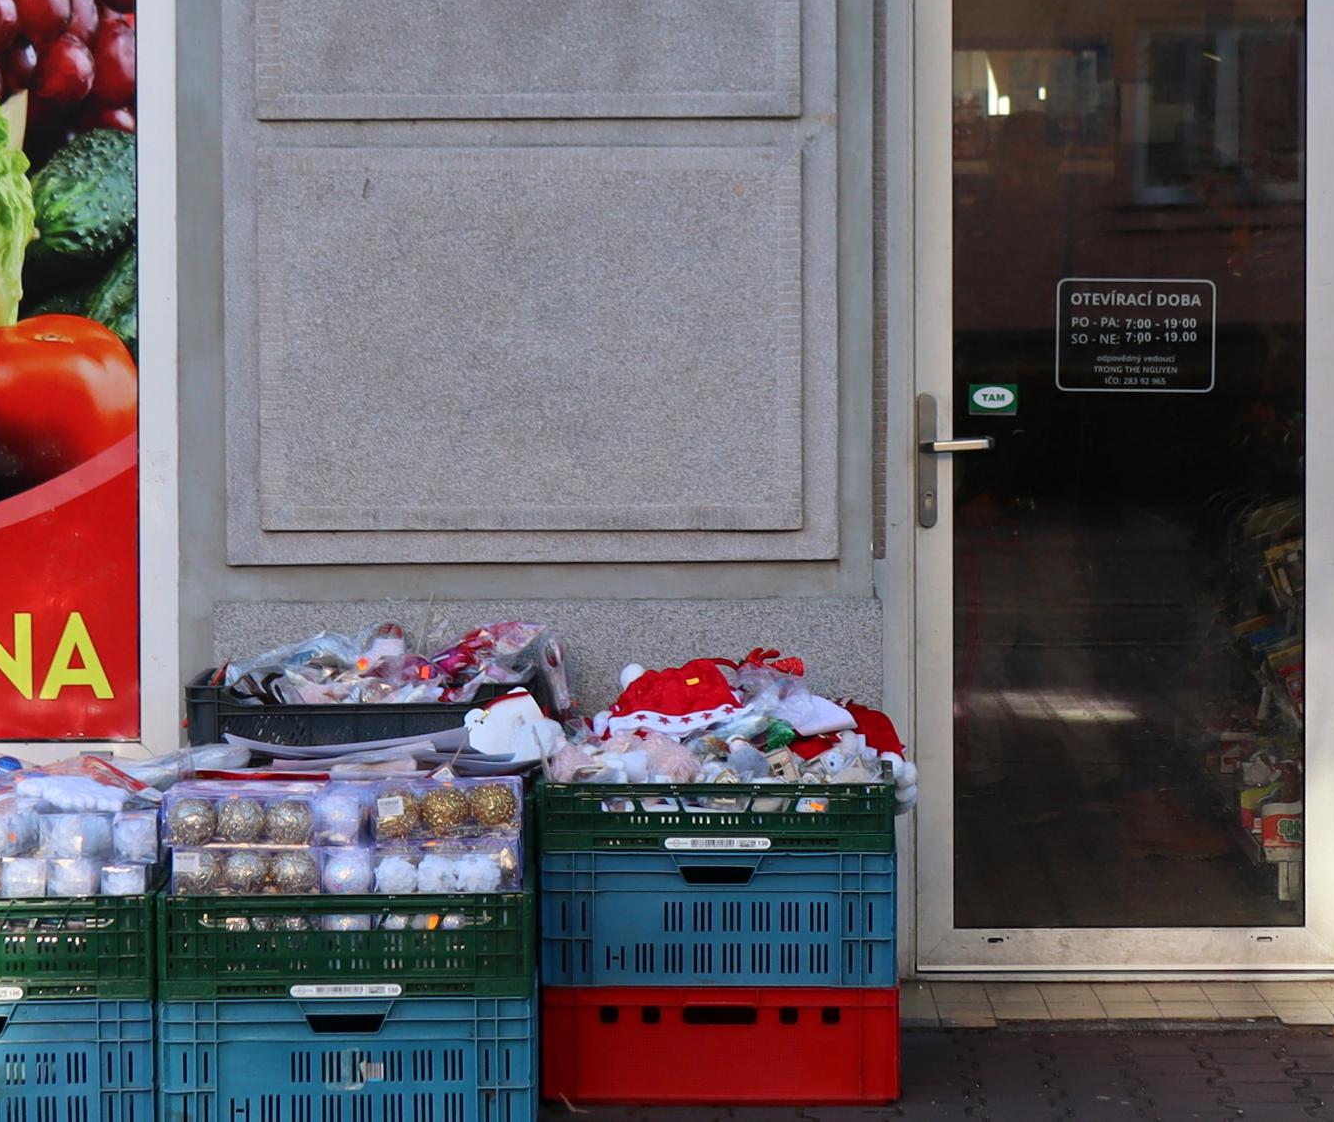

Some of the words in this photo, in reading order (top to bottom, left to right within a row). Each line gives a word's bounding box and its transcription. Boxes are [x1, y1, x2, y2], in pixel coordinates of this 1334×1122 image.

[1070, 290, 1153, 307] OTEVÍRACÍ
[1156, 293, 1202, 307] DOBA
[1071, 316, 1089, 328] PO
[1125, 318, 1152, 329] 7:00
[1071, 333, 1088, 345] SO
[1125, 332, 1152, 343] 7:00
[1094, 365, 1123, 374] TRONG
[1125, 365, 1140, 374] THE
[1142, 366, 1178, 374] NGUYEN
[981, 393, 1005, 402] TAM
